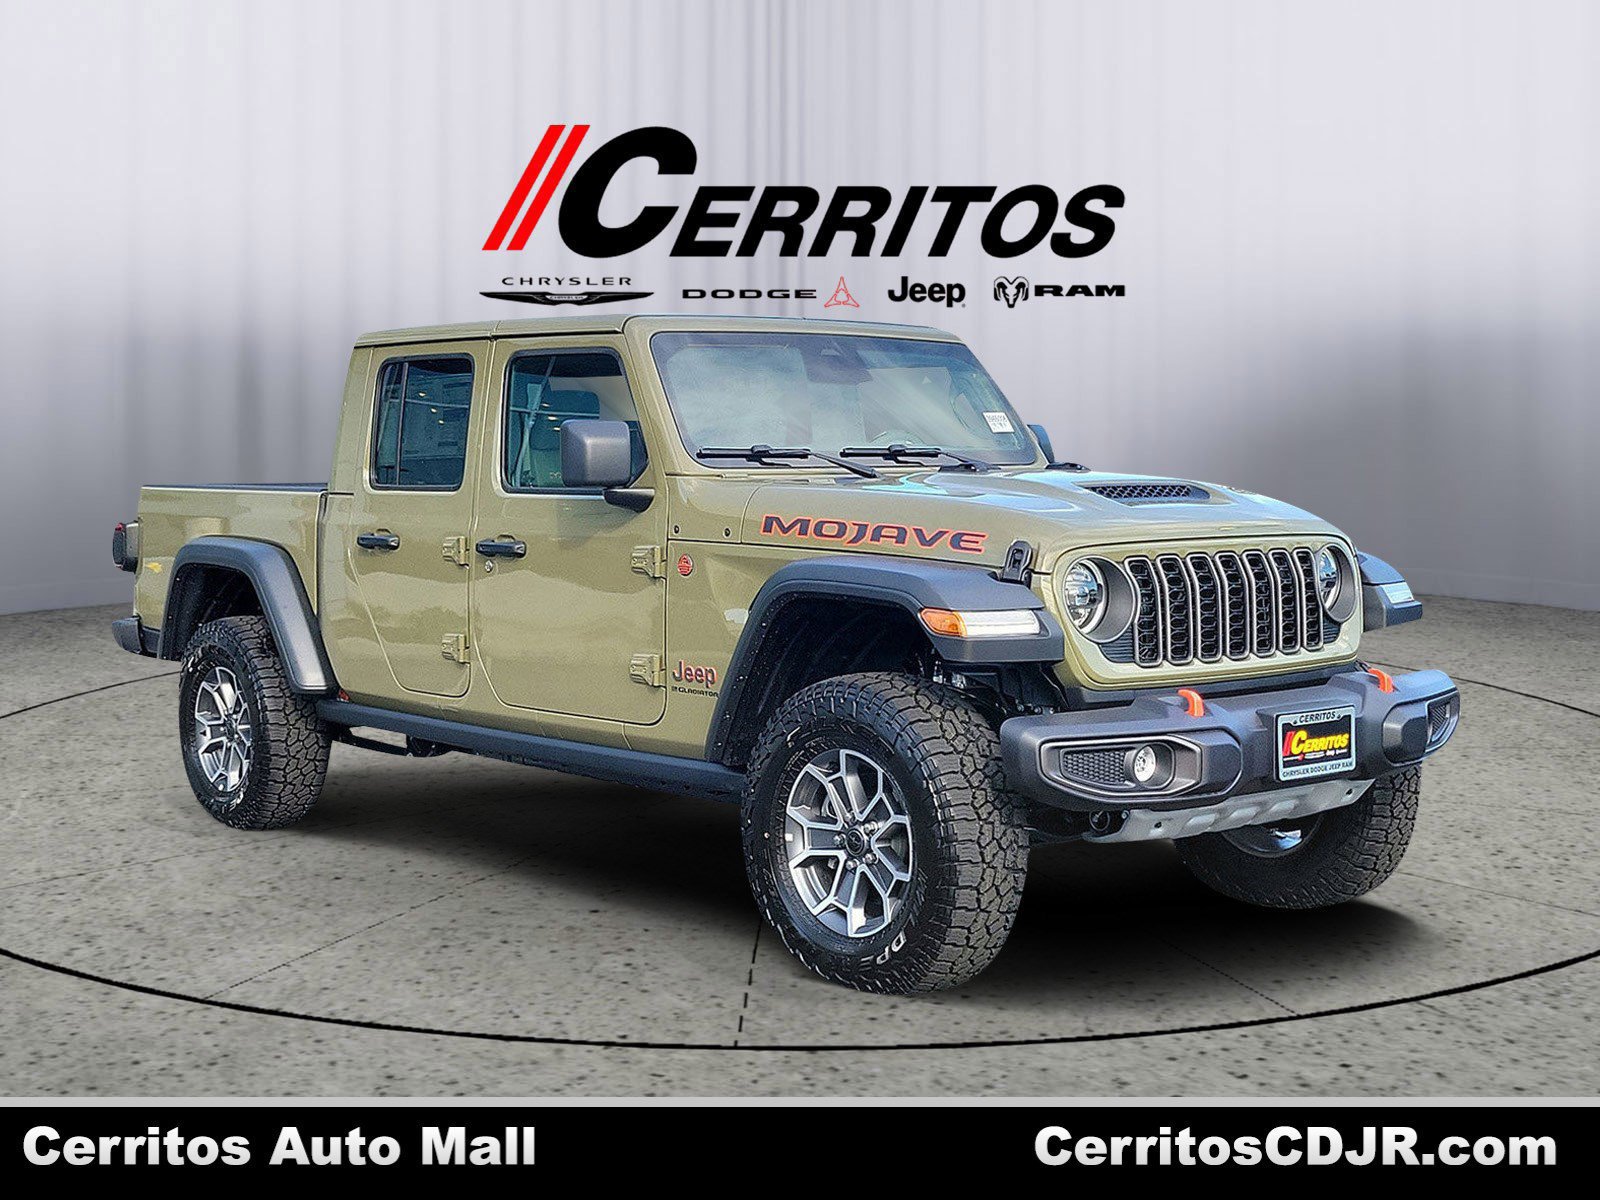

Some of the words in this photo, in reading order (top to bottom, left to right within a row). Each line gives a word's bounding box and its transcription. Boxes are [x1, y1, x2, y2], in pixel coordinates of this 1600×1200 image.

[761, 514, 987, 554] MOJAVE
[672, 659, 718, 689] Jeep
[678, 686, 719, 699] GLADIATOR
[1299, 711, 1336, 723] CERRITOS
[1290, 729, 1350, 755] CERRITOS
[1282, 768, 1310, 778] CHRYSLER
[1310, 765, 1328, 774] DODGE
[1328, 763, 1341, 771] JEEP
[1341, 761, 1353, 769] RAM
